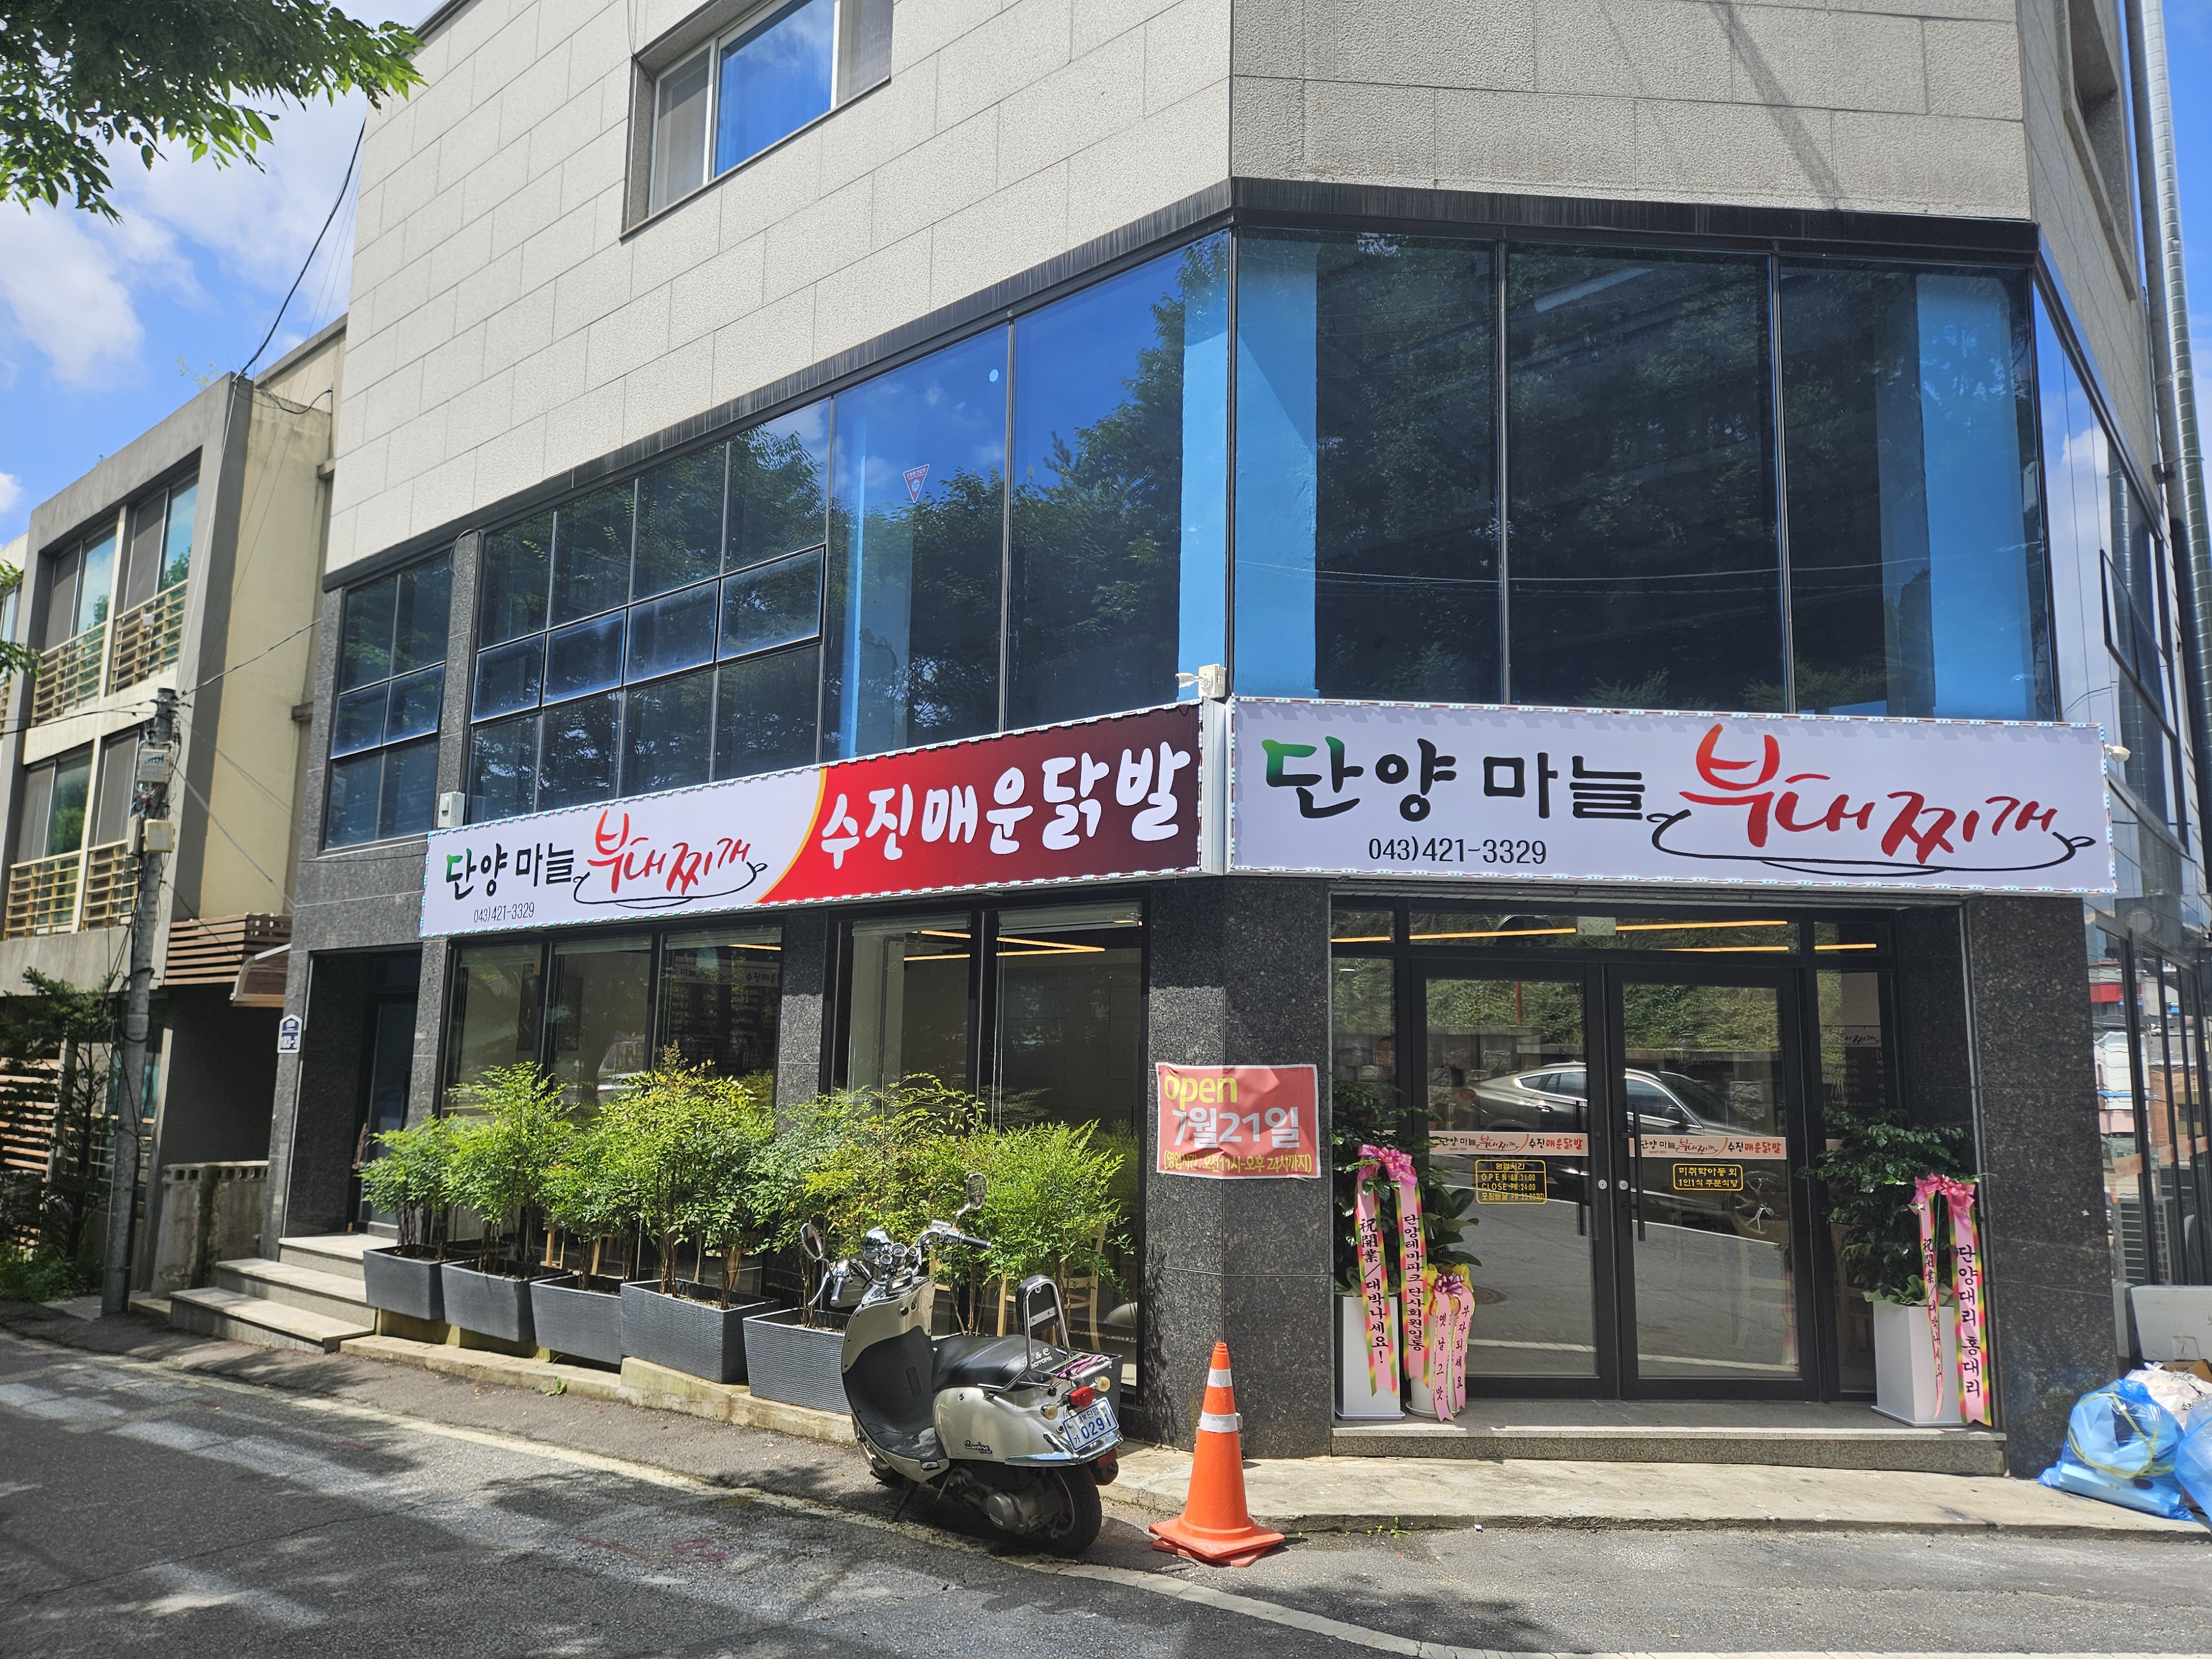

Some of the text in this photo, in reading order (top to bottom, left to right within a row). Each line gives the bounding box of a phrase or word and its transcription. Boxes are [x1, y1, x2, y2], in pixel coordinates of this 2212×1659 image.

[821, 741, 1191, 869] 수진매운닭발
[1261, 723, 2058, 864] 단양 마늘 부대찌개
[446, 810, 751, 900] 단양 마늘 부대찌개
[1369, 836, 1547, 864] 043)421-3329
[473, 902, 535, 923] 043)421-3329
[1164, 1075, 1238, 1111] open
[1172, 1107, 1300, 1149] 7월21일
[1460, 1138, 1476, 1146] 마늘
[1641, 1140, 1658, 1149] 단양
[1678, 1167, 1737, 1177] 미취학아동 외
[1679, 1178, 1738, 1187] 1인1식 주문식당
[1957, 1244, 1979, 1327] 단양대리
[1031, 1355, 1053, 1369] MOTORS
[1455, 1305, 1470, 1389] 부자되세요
[1073, 1413, 1112, 1444] 가 0291
